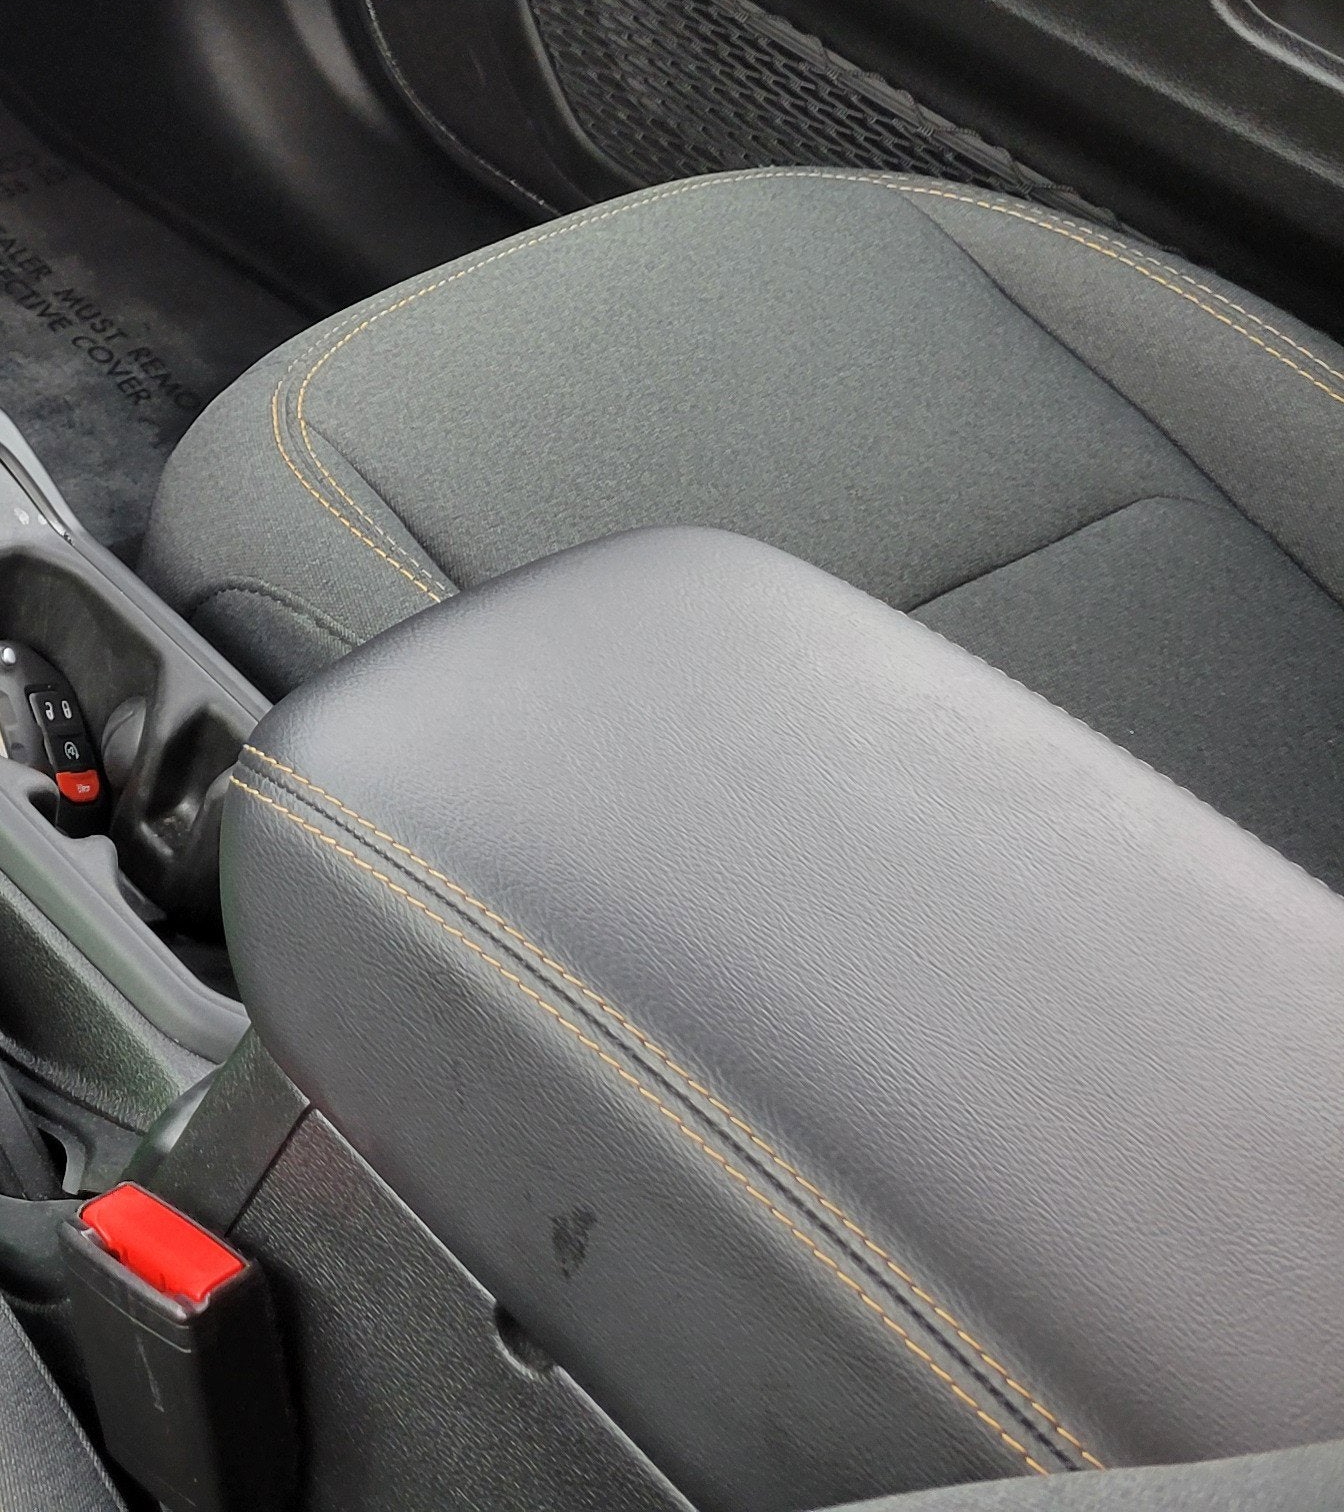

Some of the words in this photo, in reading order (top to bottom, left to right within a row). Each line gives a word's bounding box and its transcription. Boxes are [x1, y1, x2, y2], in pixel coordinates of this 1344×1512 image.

[53, 287, 129, 344] MUST
[127, 345, 204, 414] REMO
[71, 334, 152, 407] COVER
